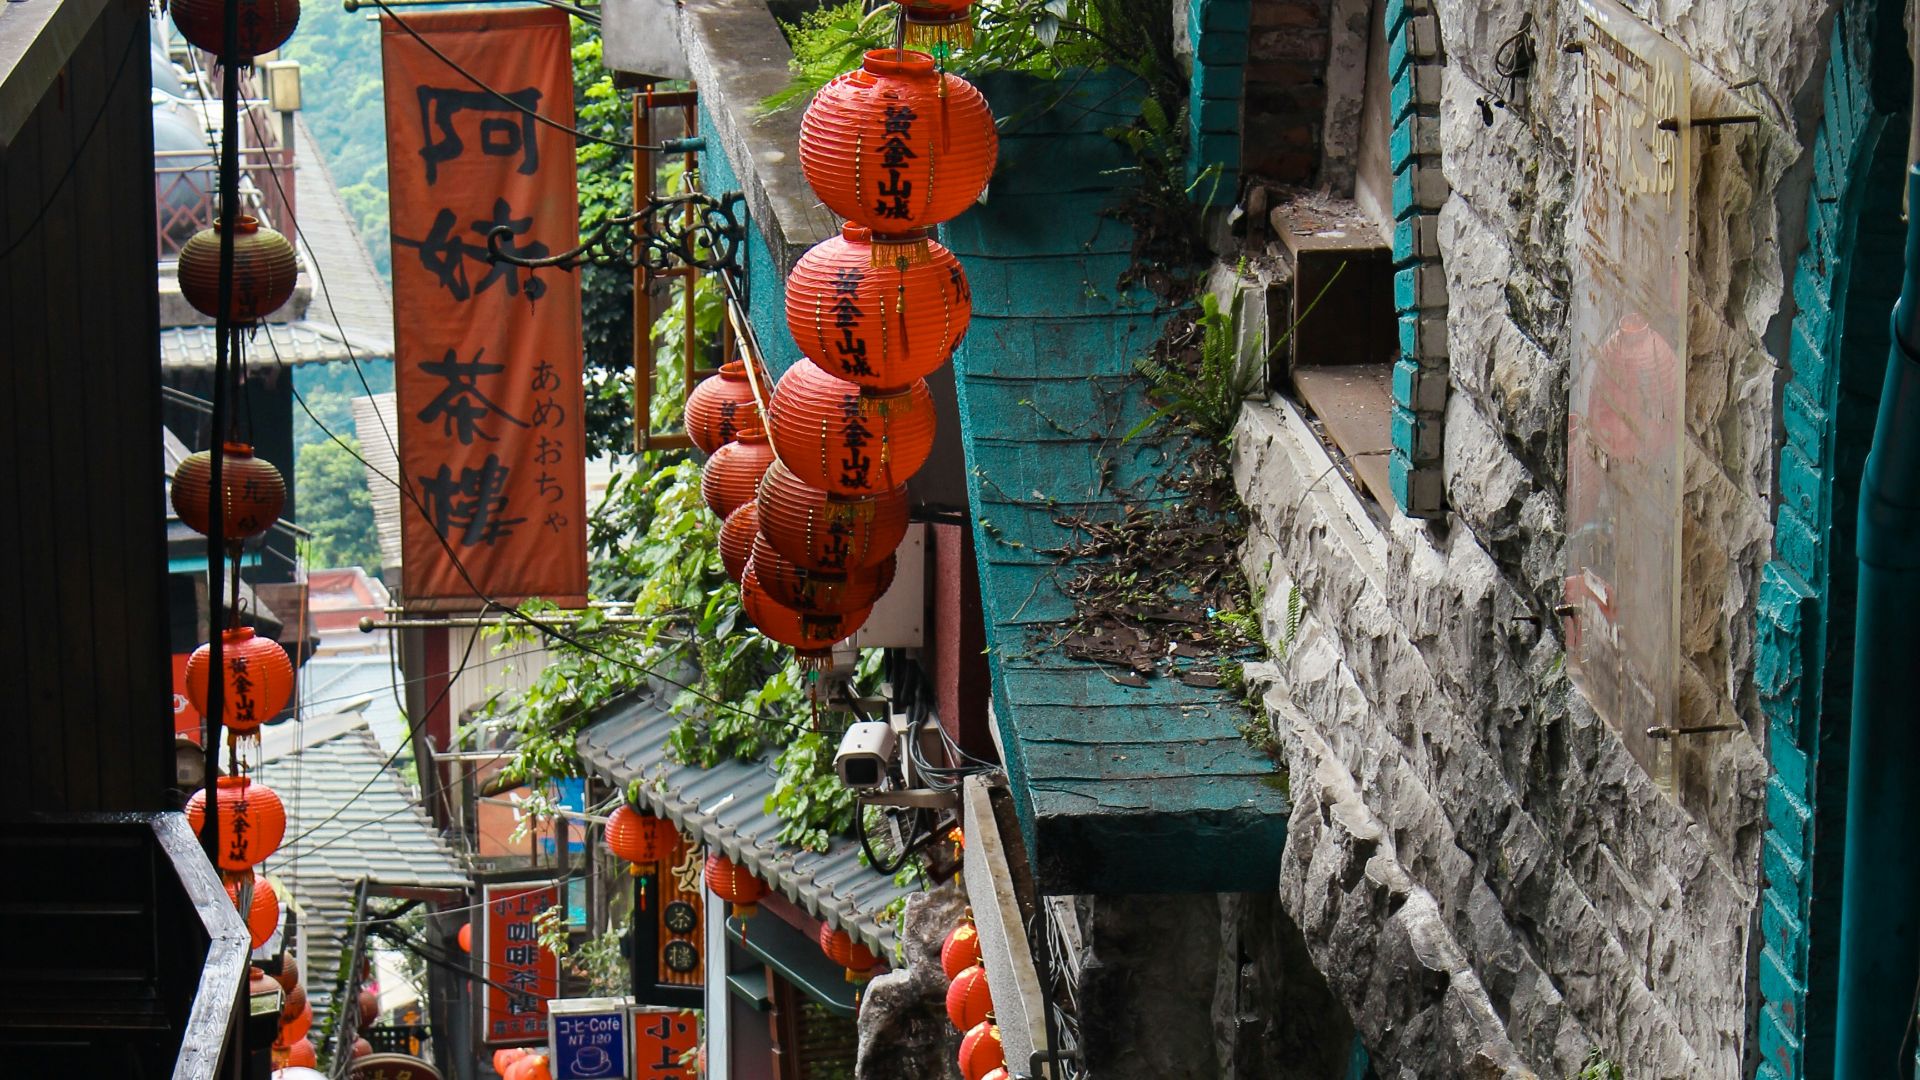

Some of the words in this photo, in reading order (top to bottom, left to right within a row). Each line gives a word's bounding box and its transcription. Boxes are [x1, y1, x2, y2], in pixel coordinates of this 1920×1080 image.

[392, 87, 549, 547] 阿妹茶樓
[530, 358, 569, 534] あめおちゃ
[569, 1035, 585, 1046] NT
